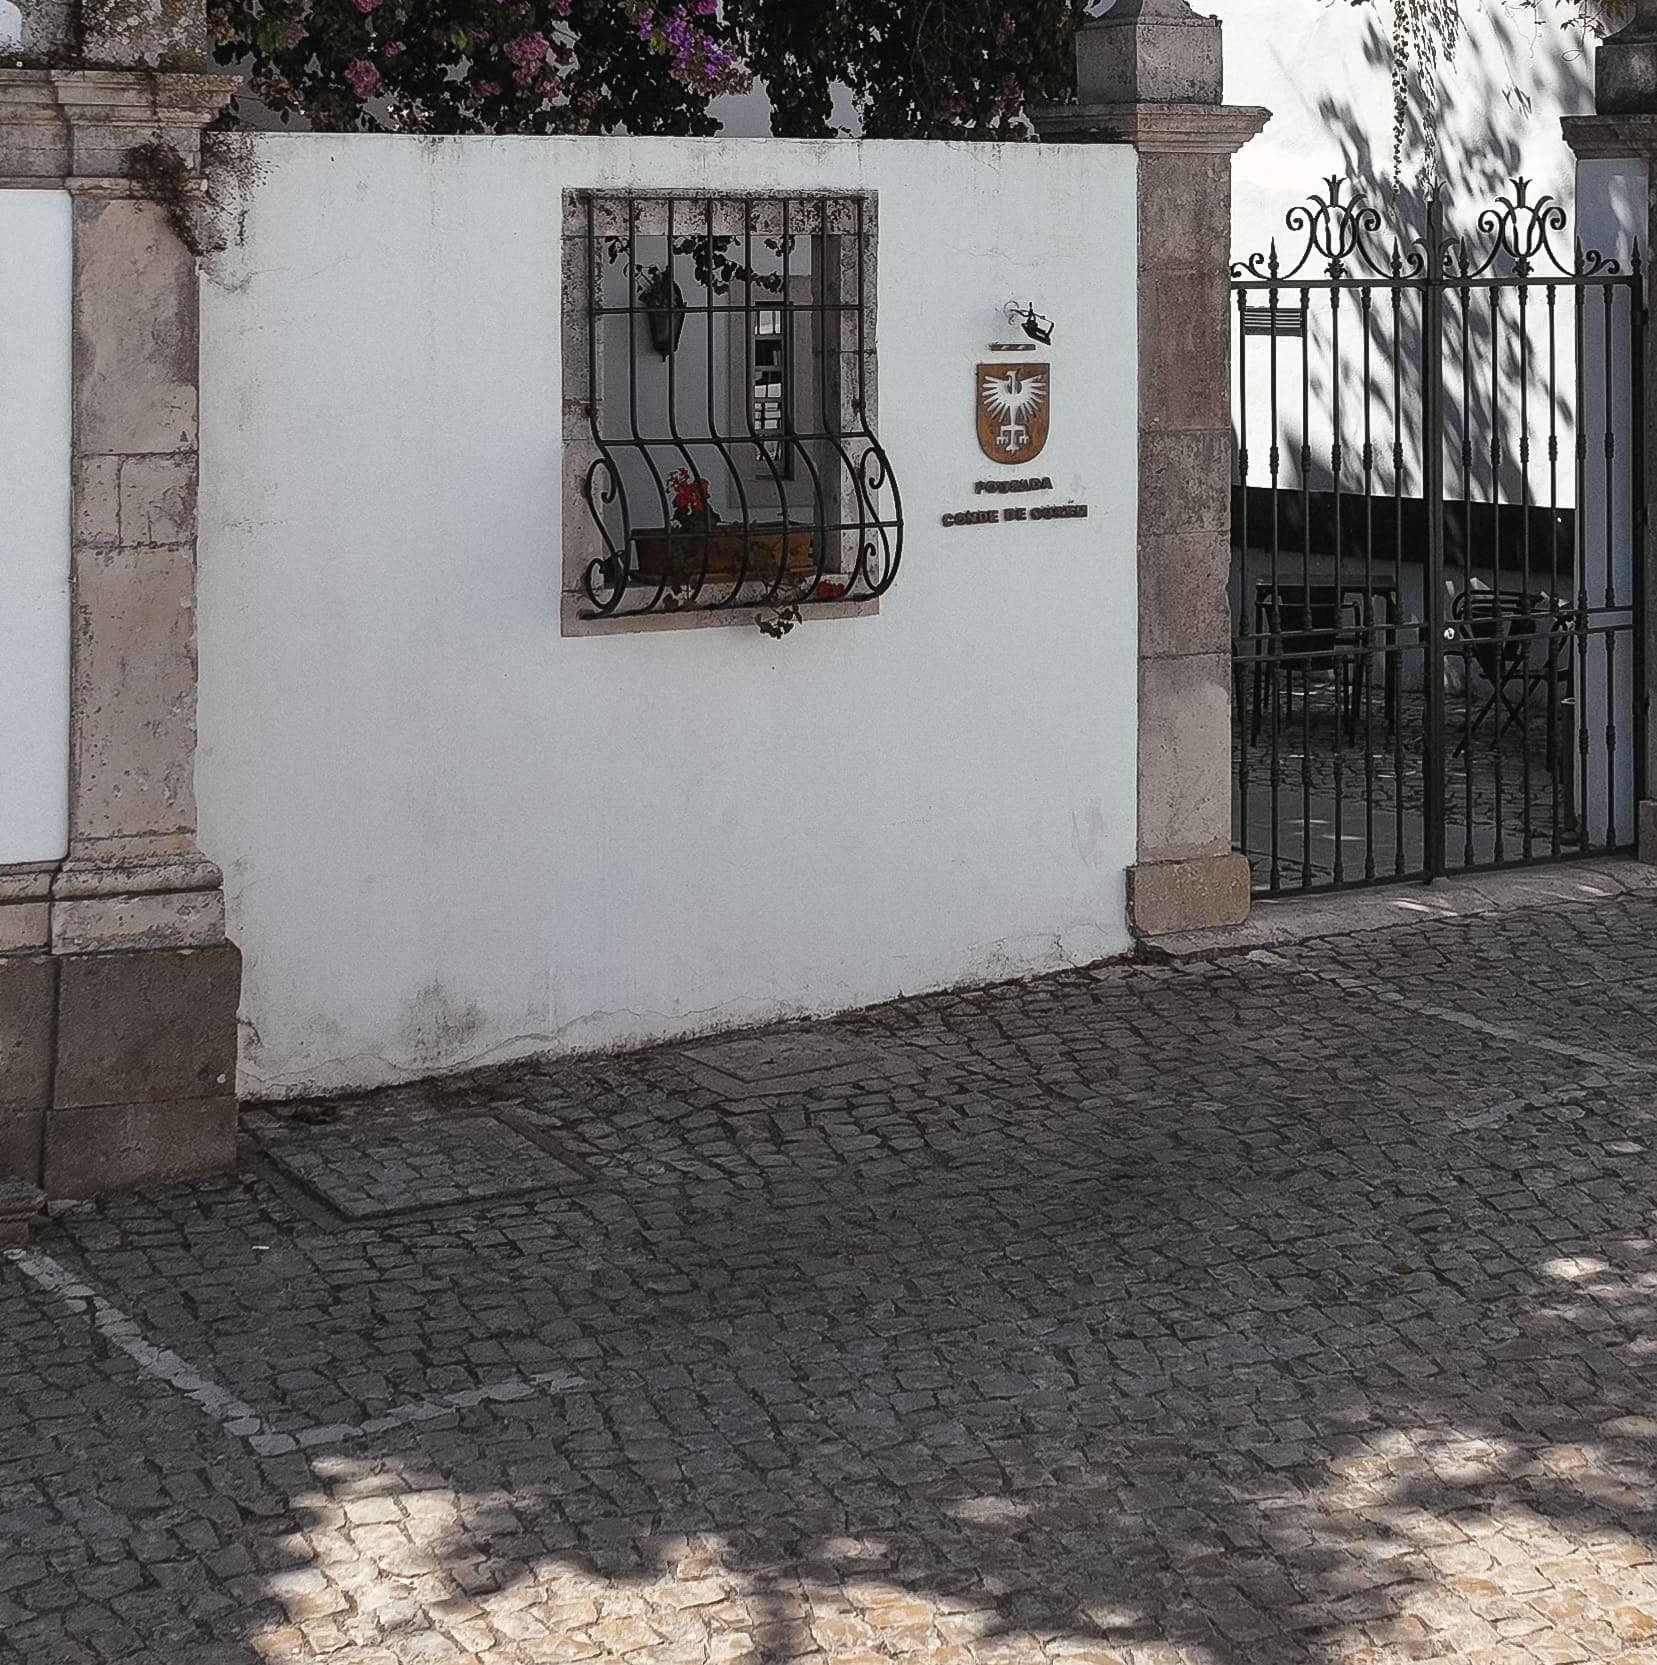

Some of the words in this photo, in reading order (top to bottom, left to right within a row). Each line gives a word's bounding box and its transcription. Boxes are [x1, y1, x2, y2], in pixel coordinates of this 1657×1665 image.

[974, 476, 1053, 494] POUSADA
[941, 509, 999, 528] CONDE
[1003, 507, 1027, 521] DE
